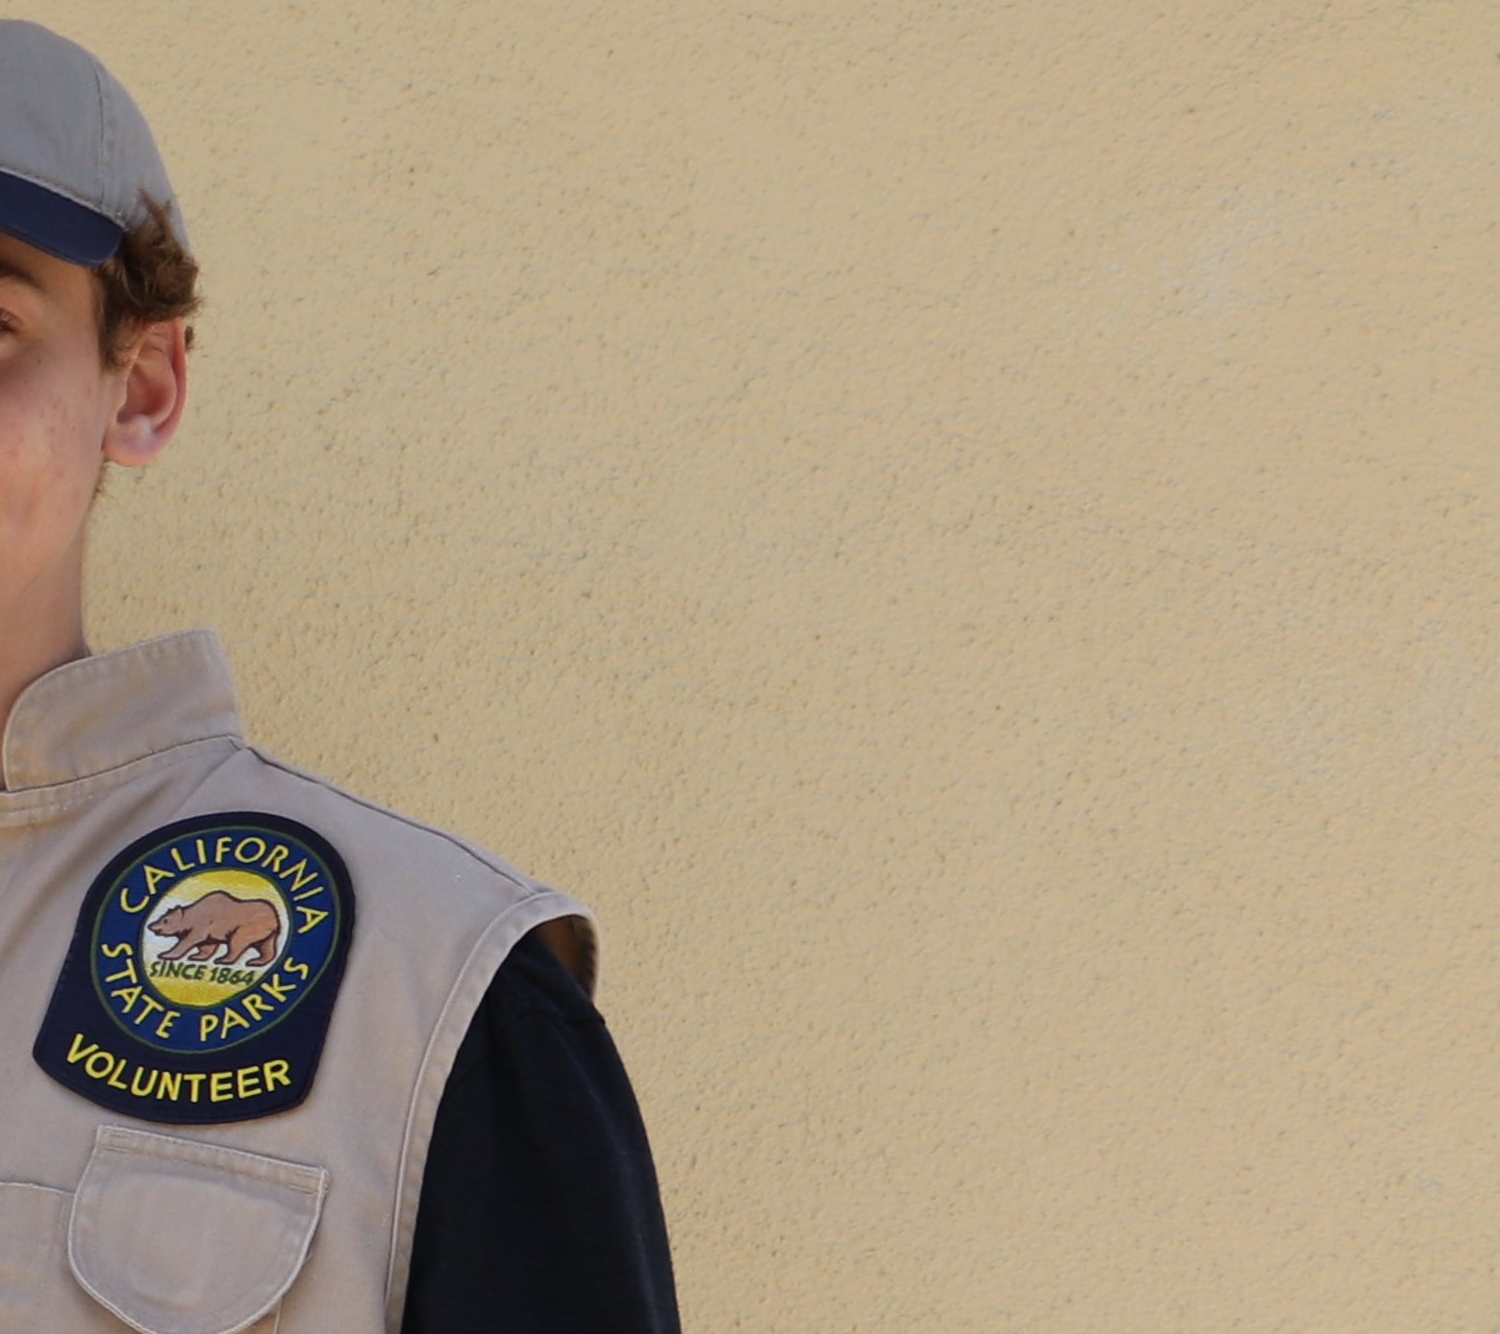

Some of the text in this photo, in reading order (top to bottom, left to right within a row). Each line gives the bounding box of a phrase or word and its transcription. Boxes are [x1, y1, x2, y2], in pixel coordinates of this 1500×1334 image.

[119, 836, 329, 934] CALIFORNIA
[101, 942, 310, 1042] STATE PARKS
[149, 960, 256, 986] SINCE 1864
[66, 1032, 292, 1103] VOLUNTEER
